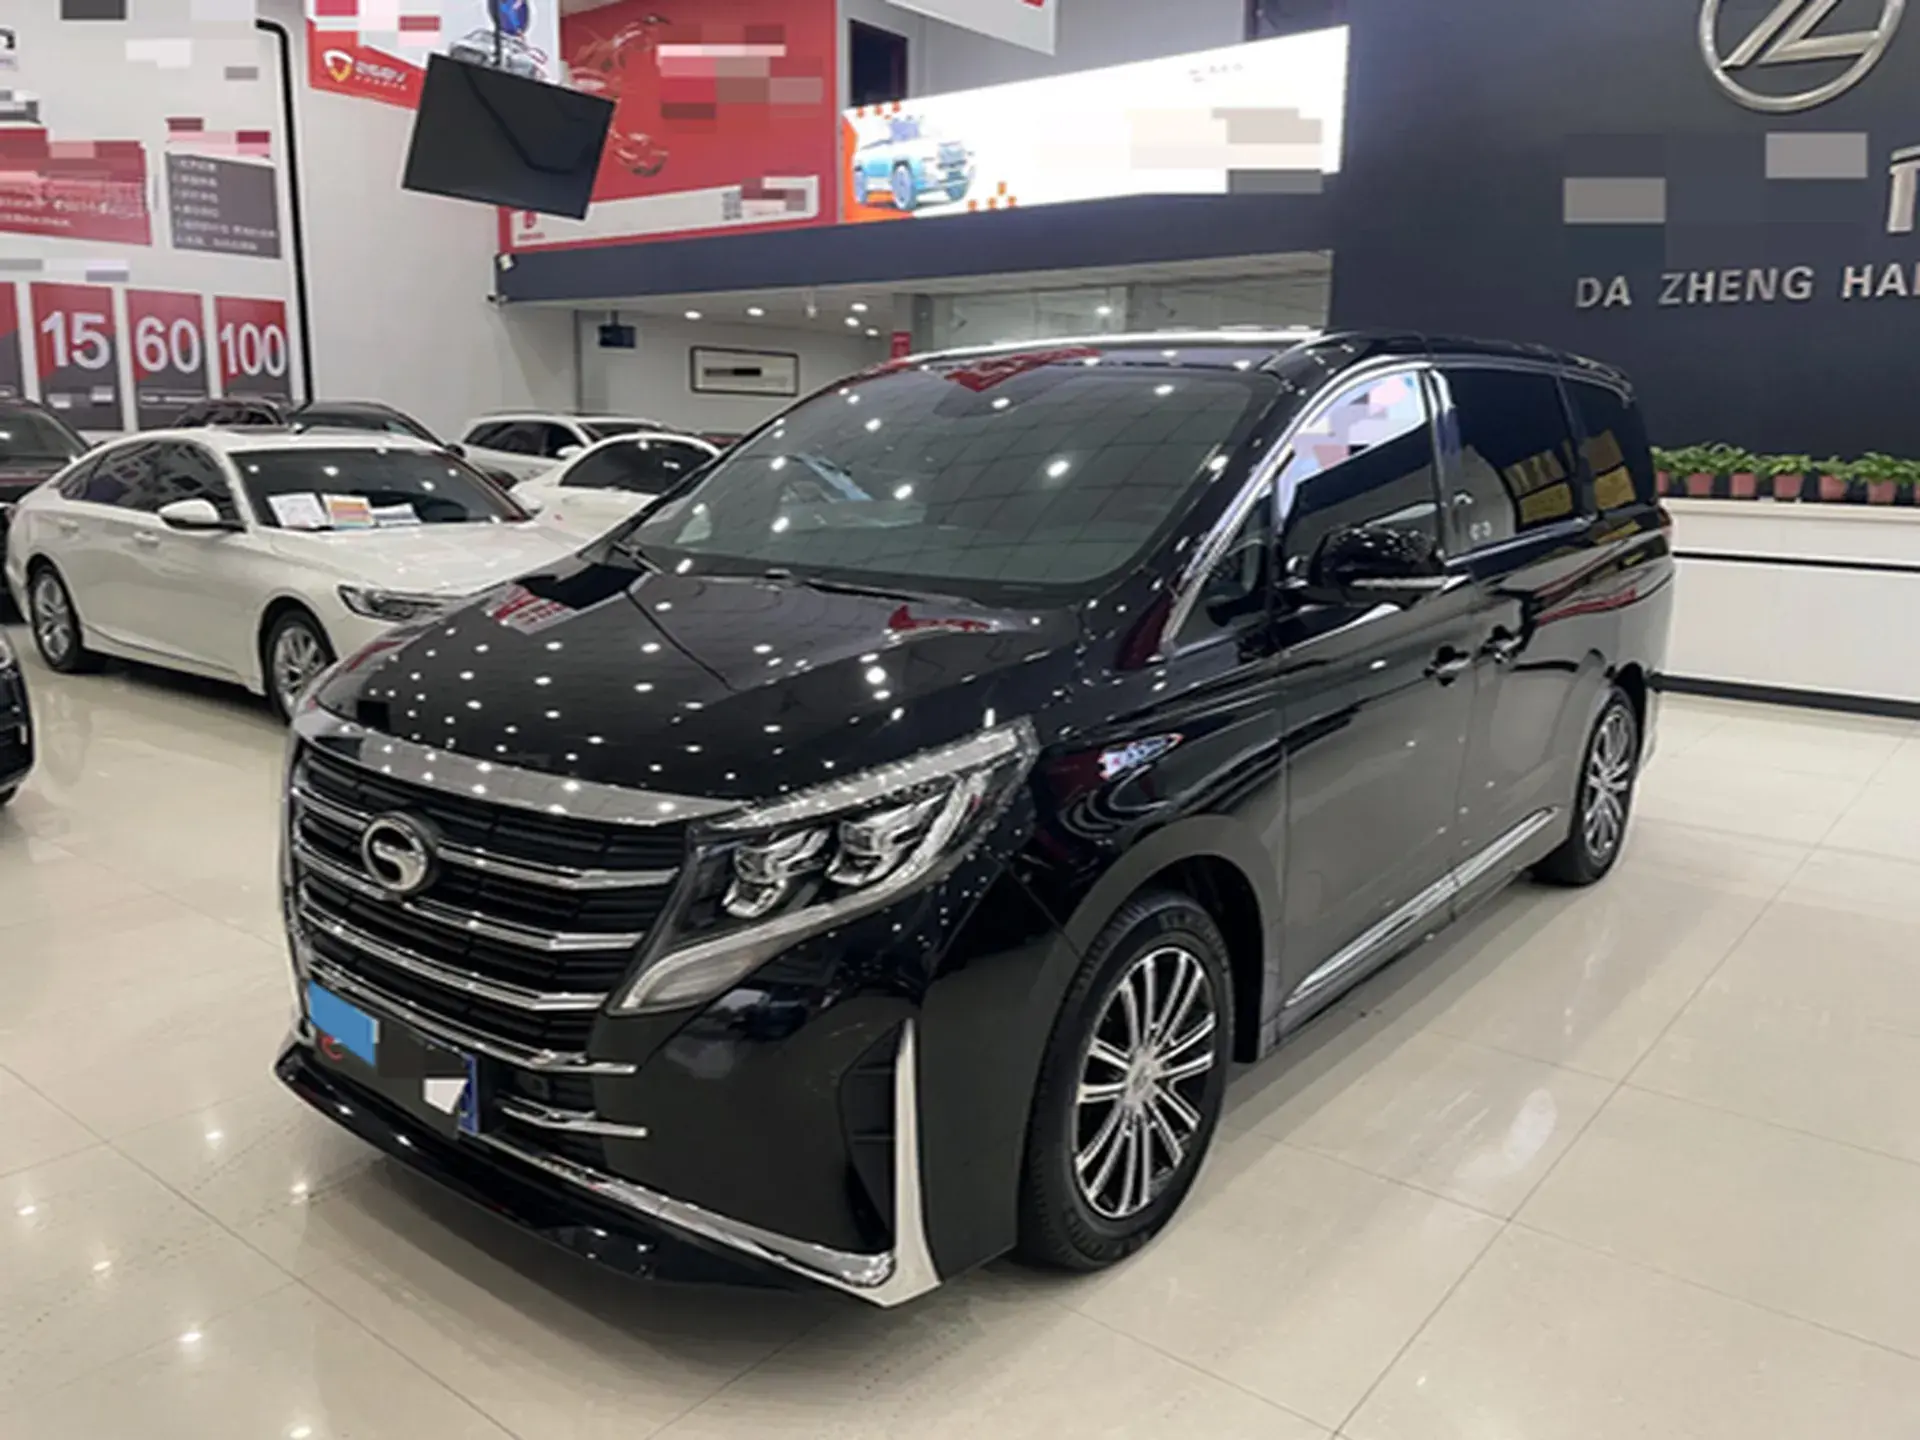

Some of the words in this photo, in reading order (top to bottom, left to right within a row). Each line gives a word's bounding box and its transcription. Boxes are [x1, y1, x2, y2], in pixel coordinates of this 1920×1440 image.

[1575, 275, 1632, 308] DA
[1658, 266, 1815, 306] ZHENG
[1840, 261, 1920, 299] HA
[40, 310, 111, 370] 15
[135, 315, 201, 374] 60
[220, 321, 287, 378] 100
